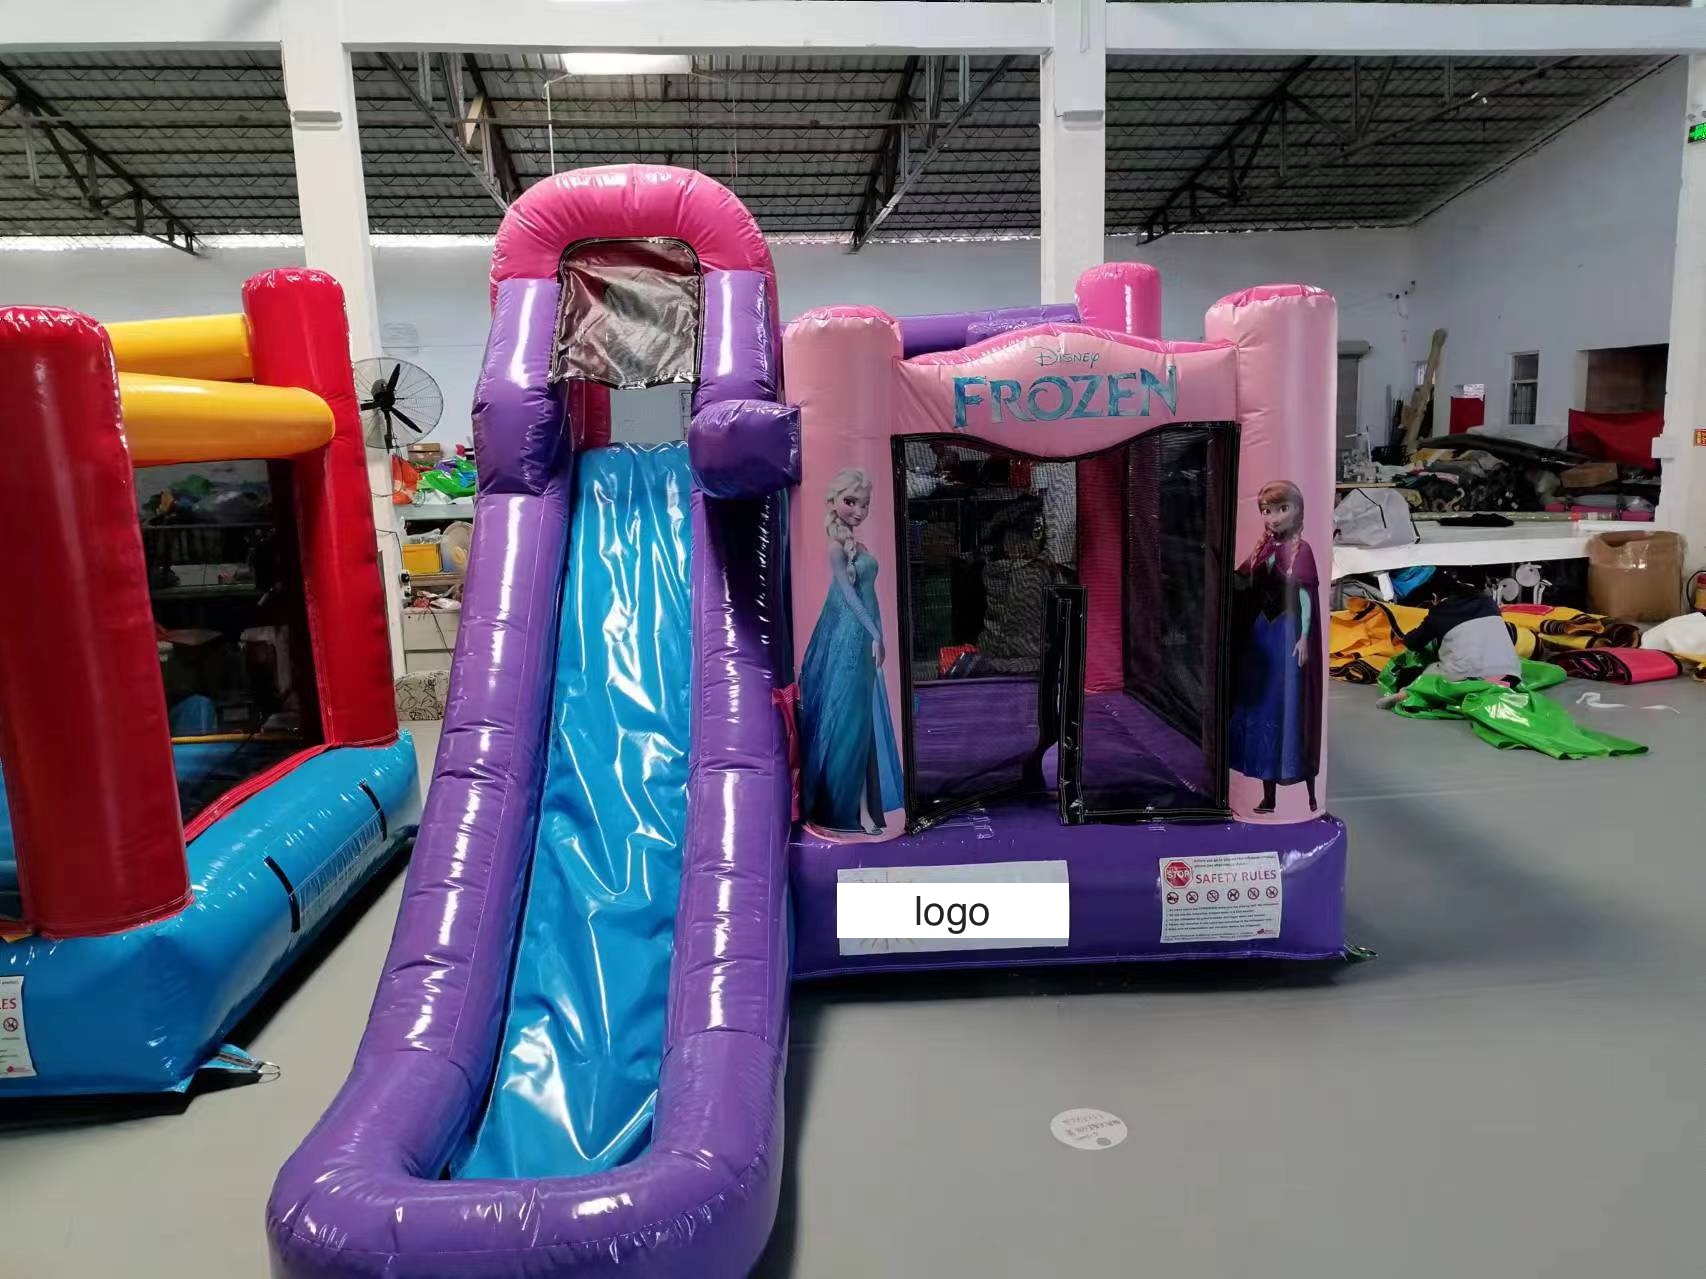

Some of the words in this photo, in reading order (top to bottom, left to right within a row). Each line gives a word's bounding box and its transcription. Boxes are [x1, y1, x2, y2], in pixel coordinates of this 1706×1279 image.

[952, 365, 1177, 428] FROZEN
[1166, 870, 1190, 879] STOP
[1195, 871, 1237, 884] SAFETY
[1242, 869, 1277, 881] RULES
